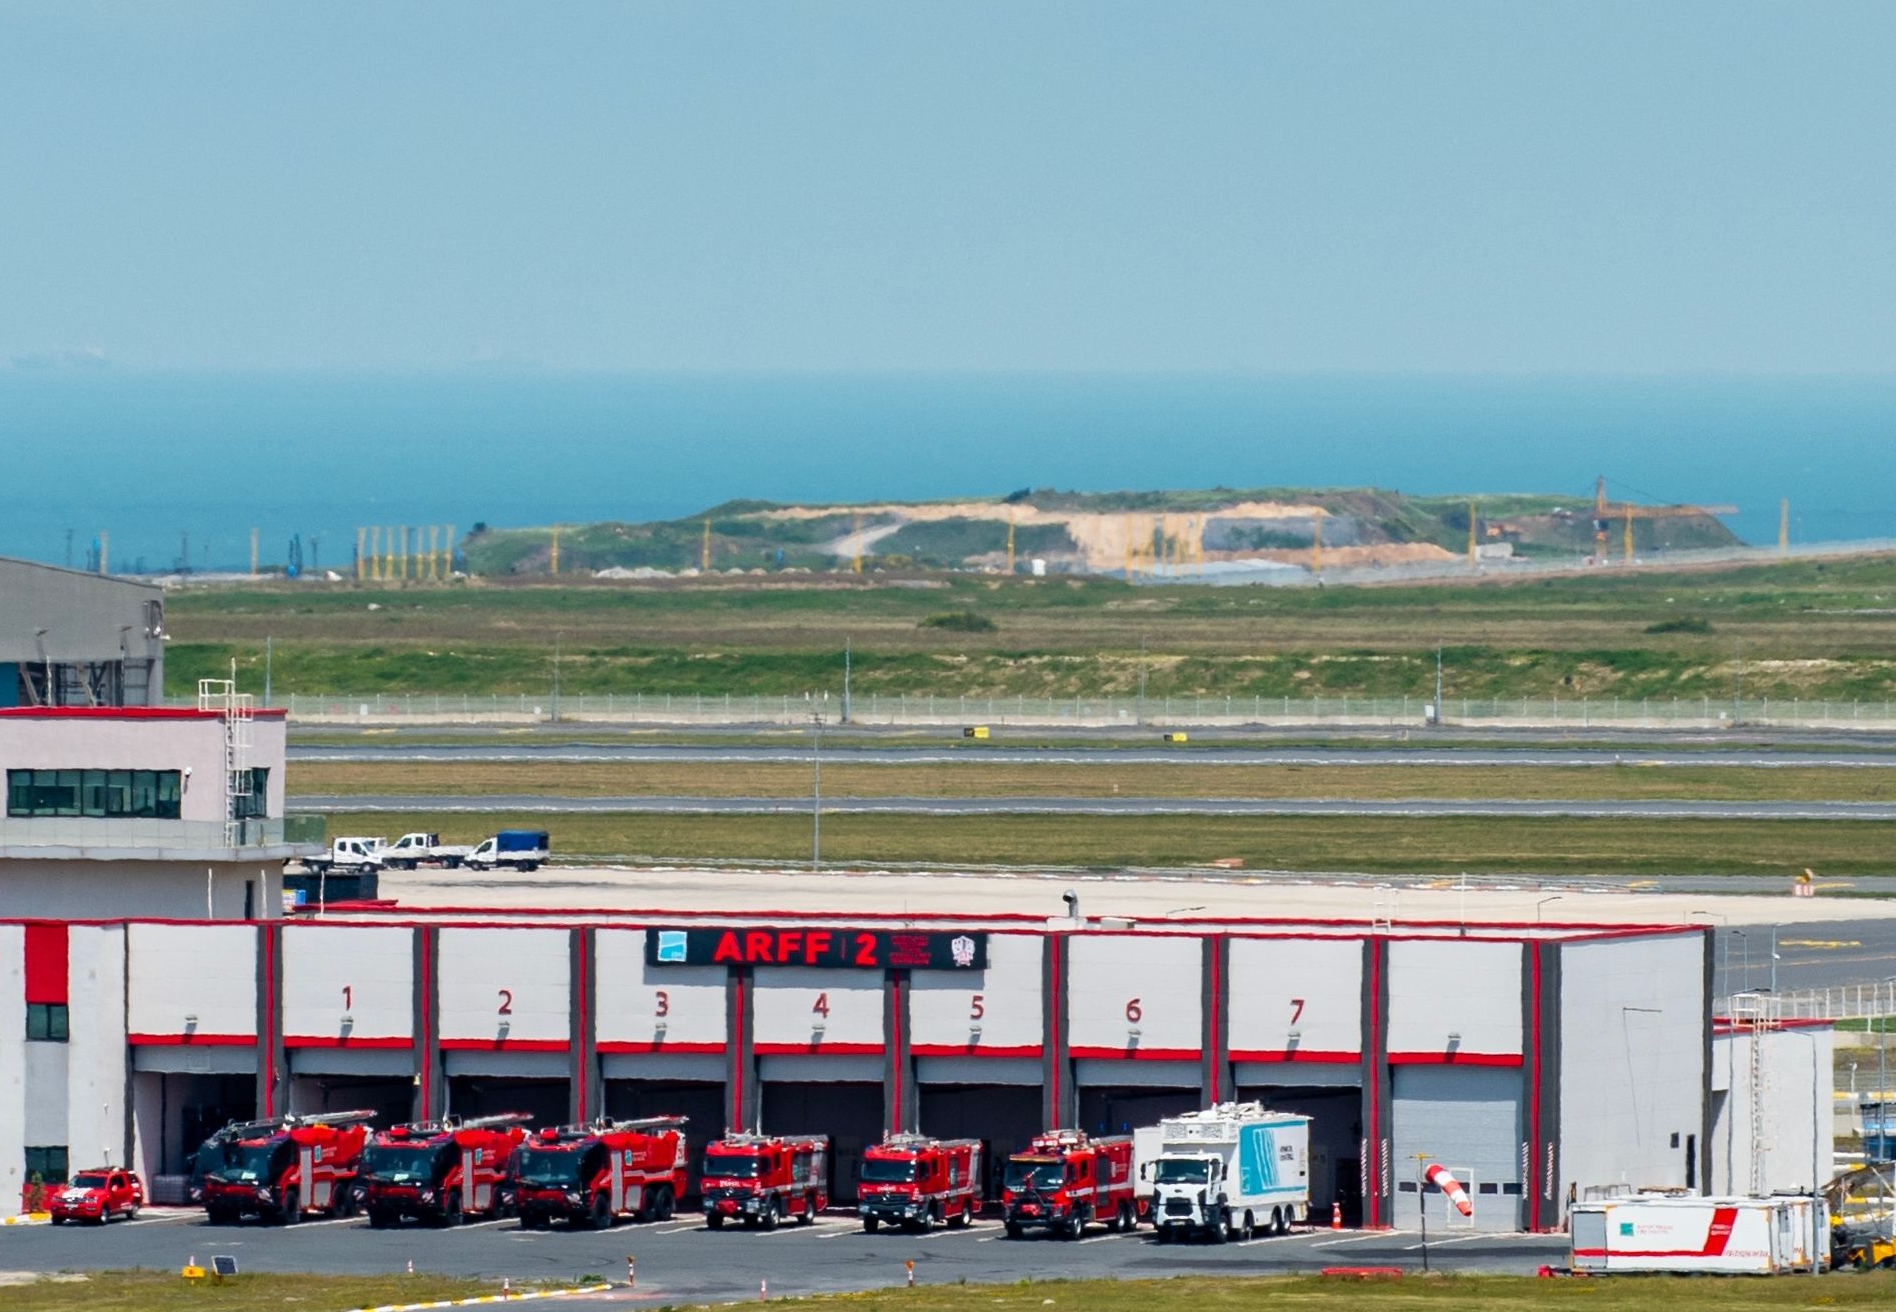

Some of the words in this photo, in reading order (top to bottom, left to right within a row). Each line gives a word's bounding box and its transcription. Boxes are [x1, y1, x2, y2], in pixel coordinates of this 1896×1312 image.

[713, 931, 833, 963] ARFF
[854, 933, 877, 965] 2
[342, 986, 353, 1010] 1
[498, 989, 513, 1015] 2
[655, 991, 669, 1017] 3
[813, 992, 831, 1018] 4
[970, 995, 985, 1019] 5
[1125, 997, 1143, 1022] 6
[1289, 998, 1305, 1025] 7
